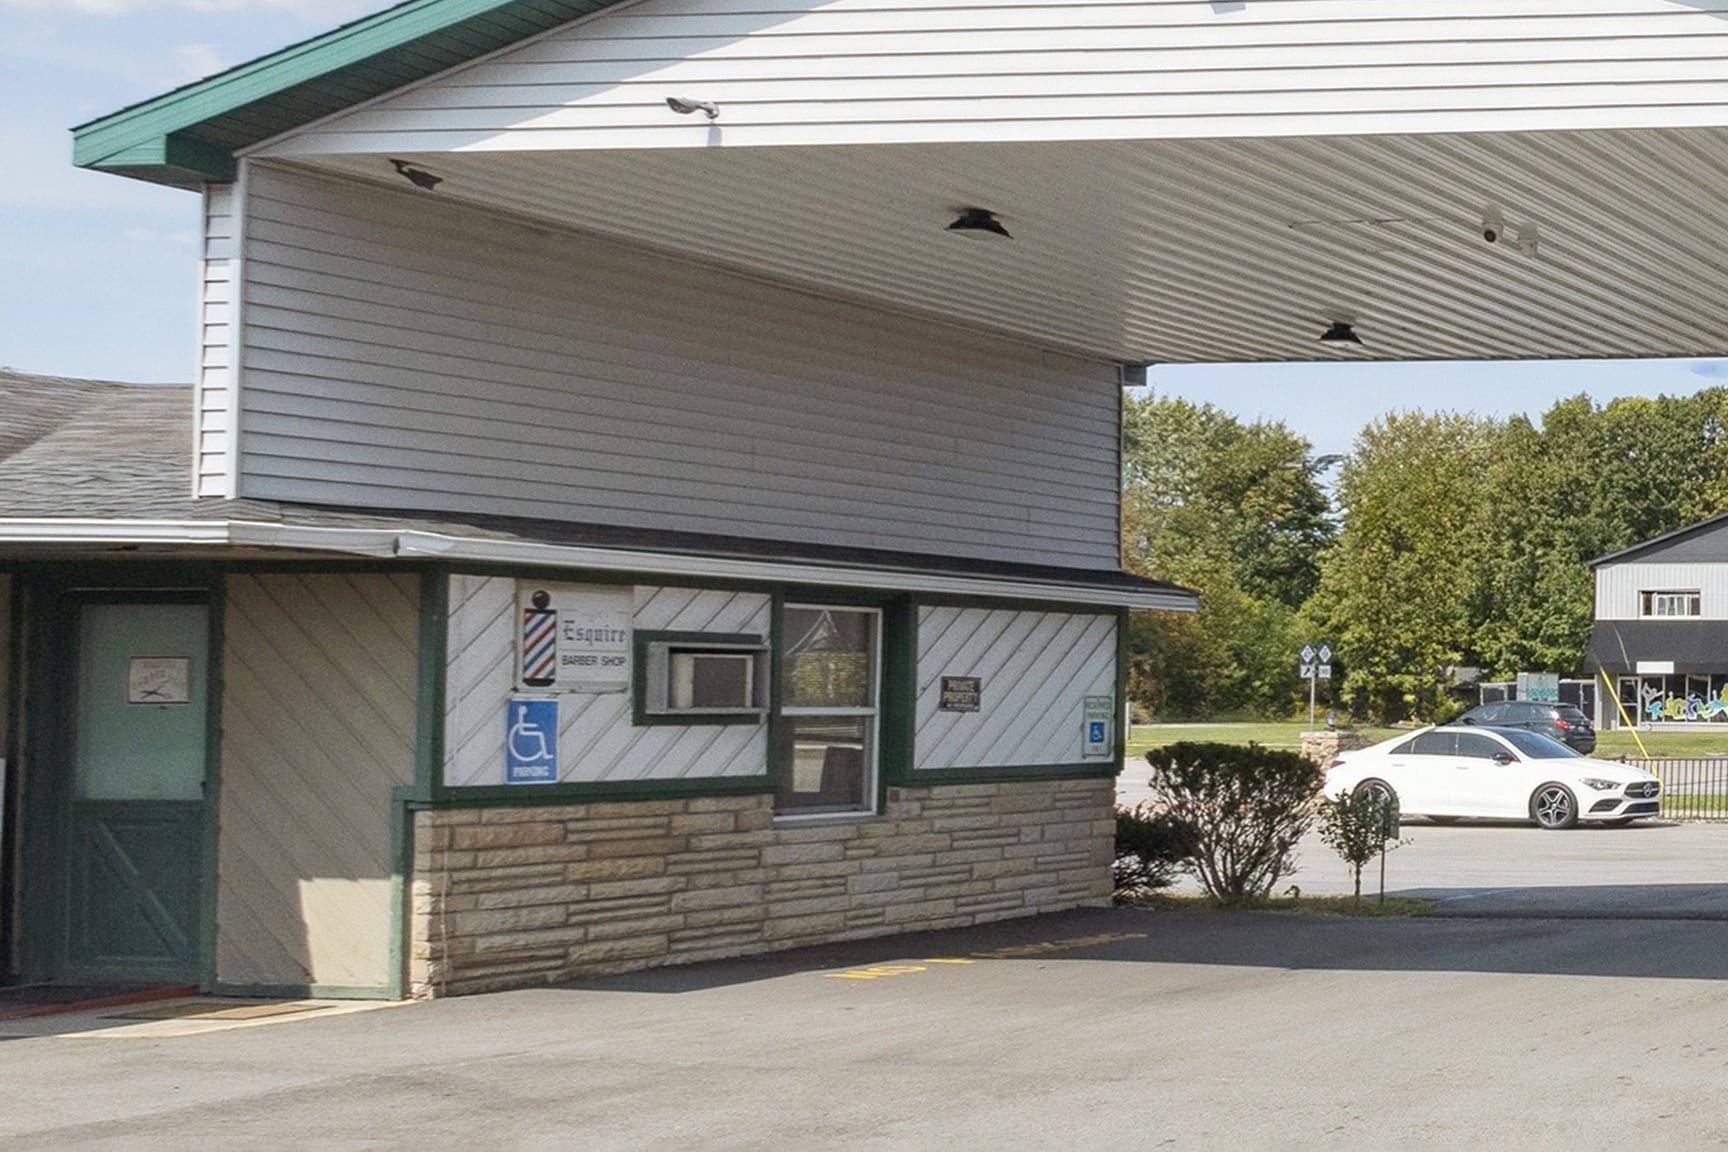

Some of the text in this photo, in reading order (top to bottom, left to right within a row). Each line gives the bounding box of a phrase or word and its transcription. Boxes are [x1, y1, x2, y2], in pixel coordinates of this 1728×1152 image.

[563, 620, 626, 646] Esquire
[562, 654, 626, 666] BARBER SHOP
